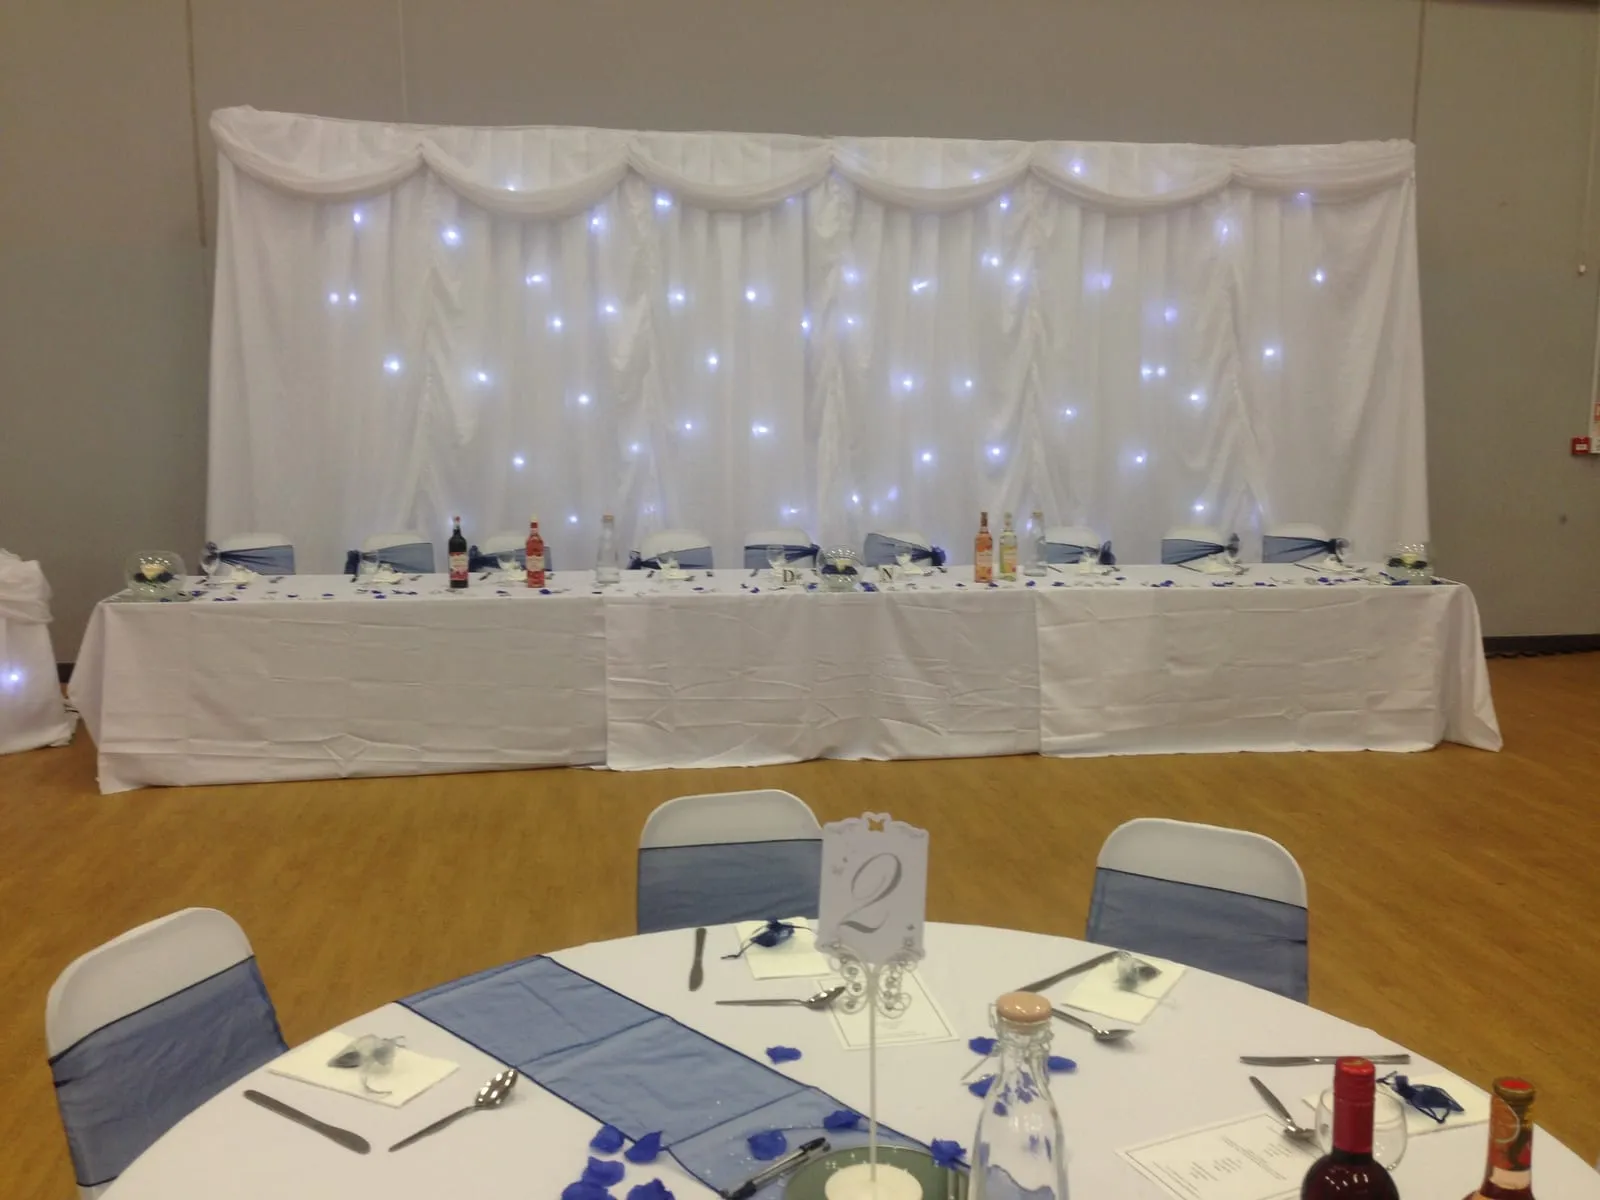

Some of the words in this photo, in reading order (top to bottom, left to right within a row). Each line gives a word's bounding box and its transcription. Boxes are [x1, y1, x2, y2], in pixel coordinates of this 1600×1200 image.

[783, 569, 795, 582] D
[881, 567, 893, 582] N
[839, 853, 902, 933] 2
